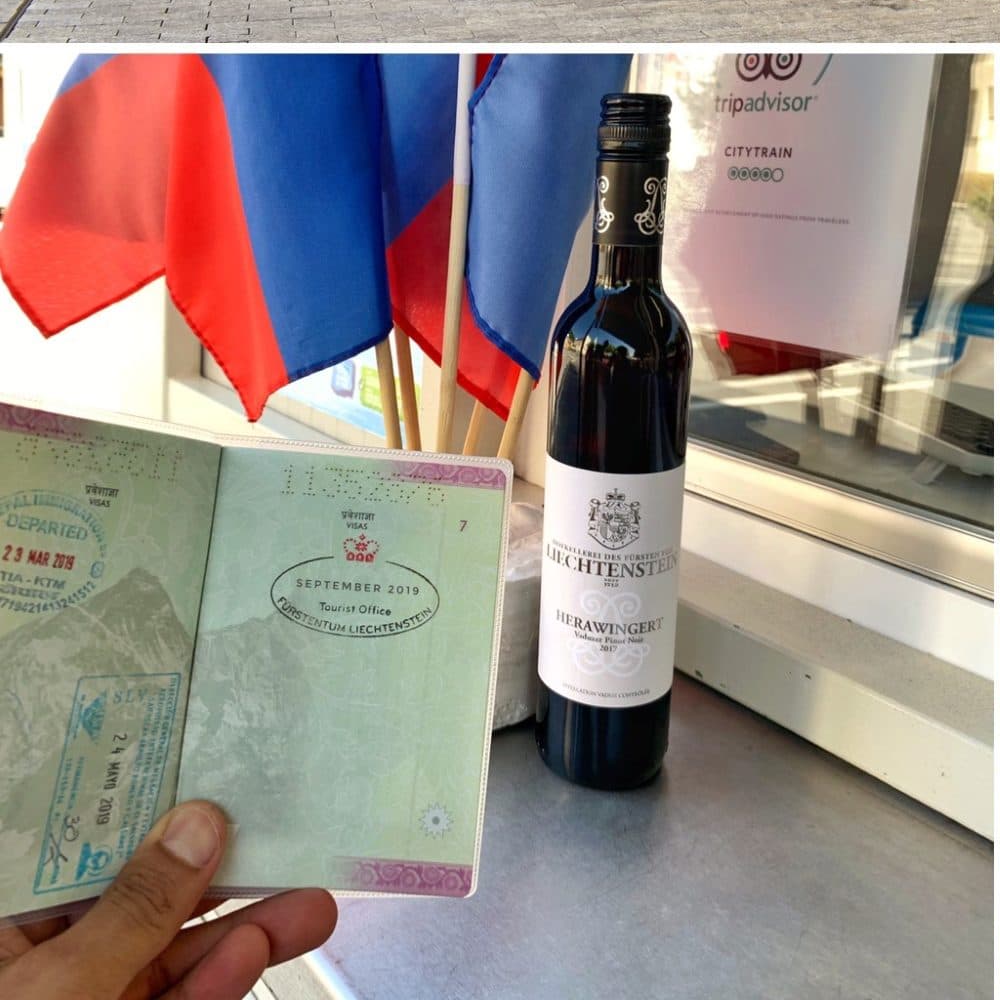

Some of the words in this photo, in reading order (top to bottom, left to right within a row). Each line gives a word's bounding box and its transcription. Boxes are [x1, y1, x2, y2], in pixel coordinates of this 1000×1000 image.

[714, 90, 812, 118] tripadvisor
[724, 146, 793, 158] CITYTRAIN
[89, 499, 110, 508] VISAS
[6, 513, 88, 541] DEPARTED
[346, 522, 368, 530] VISAS
[459, 519, 468, 532] 7
[27, 549, 50, 567] MAR
[52, 552, 76, 571] 2019
[547, 543, 678, 578] LIECHTENSTEIN
[296, 578, 381, 593] SEPTEMBER
[388, 585, 420, 595] 2019
[276, 596, 346, 632] FÜRSTENTUM
[349, 607, 433, 635] LIECHTENSTEIN
[319, 601, 355, 614] Tourist
[358, 604, 392, 616] Office
[556, 608, 664, 636] HERAWINGERT
[600, 644, 617, 653] 2017
[103, 761, 121, 791] MAYO
[96, 797, 114, 826] 2019
